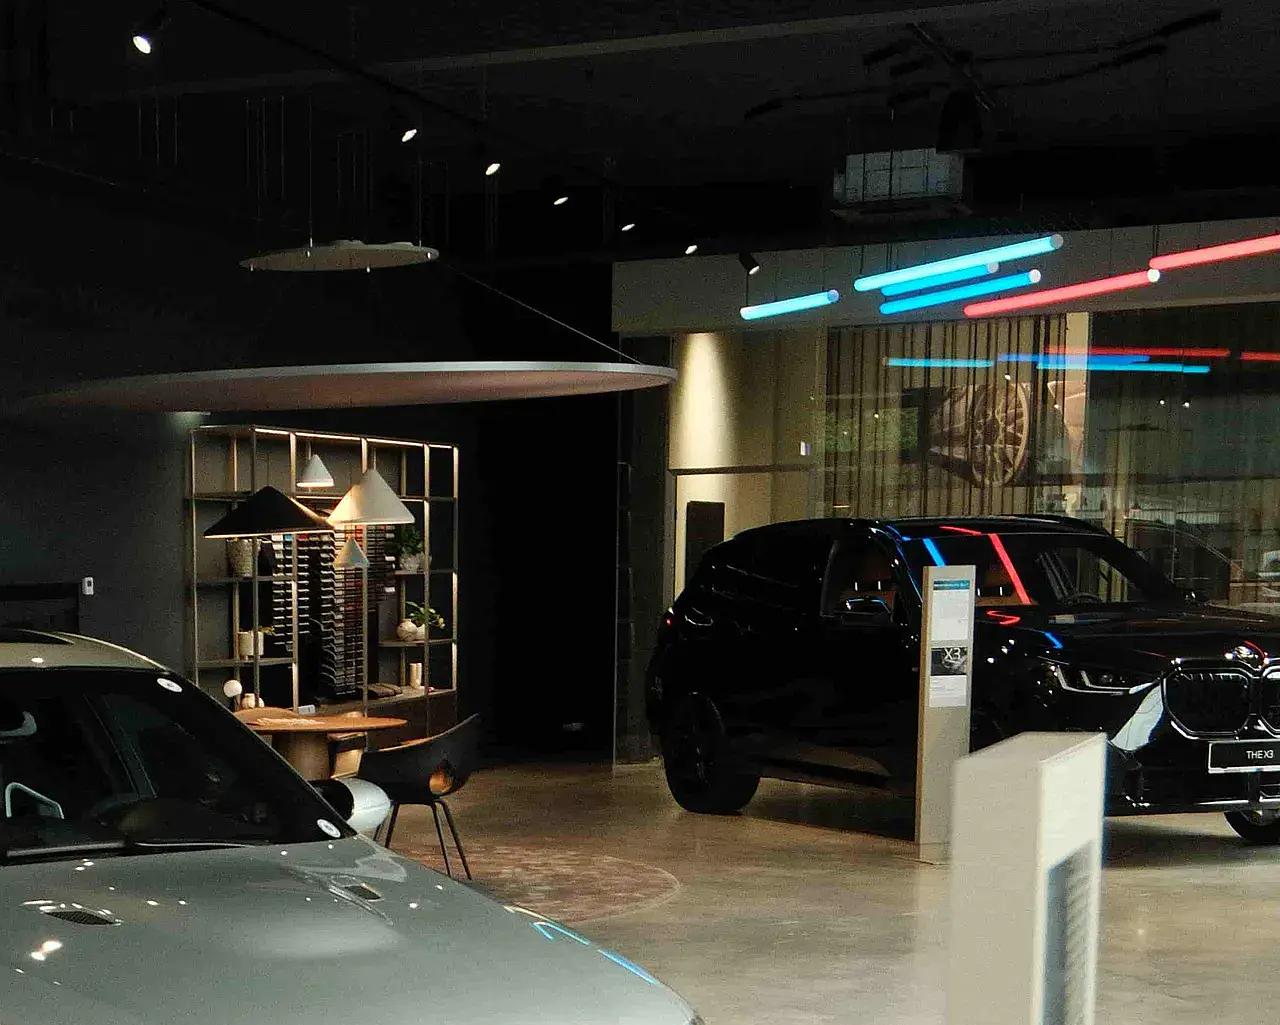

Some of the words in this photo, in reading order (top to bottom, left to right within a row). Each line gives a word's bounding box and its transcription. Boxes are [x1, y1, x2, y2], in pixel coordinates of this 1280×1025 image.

[944, 647, 962, 661] X3
[1246, 750, 1263, 760] THE
[1263, 749, 1274, 759] X3
